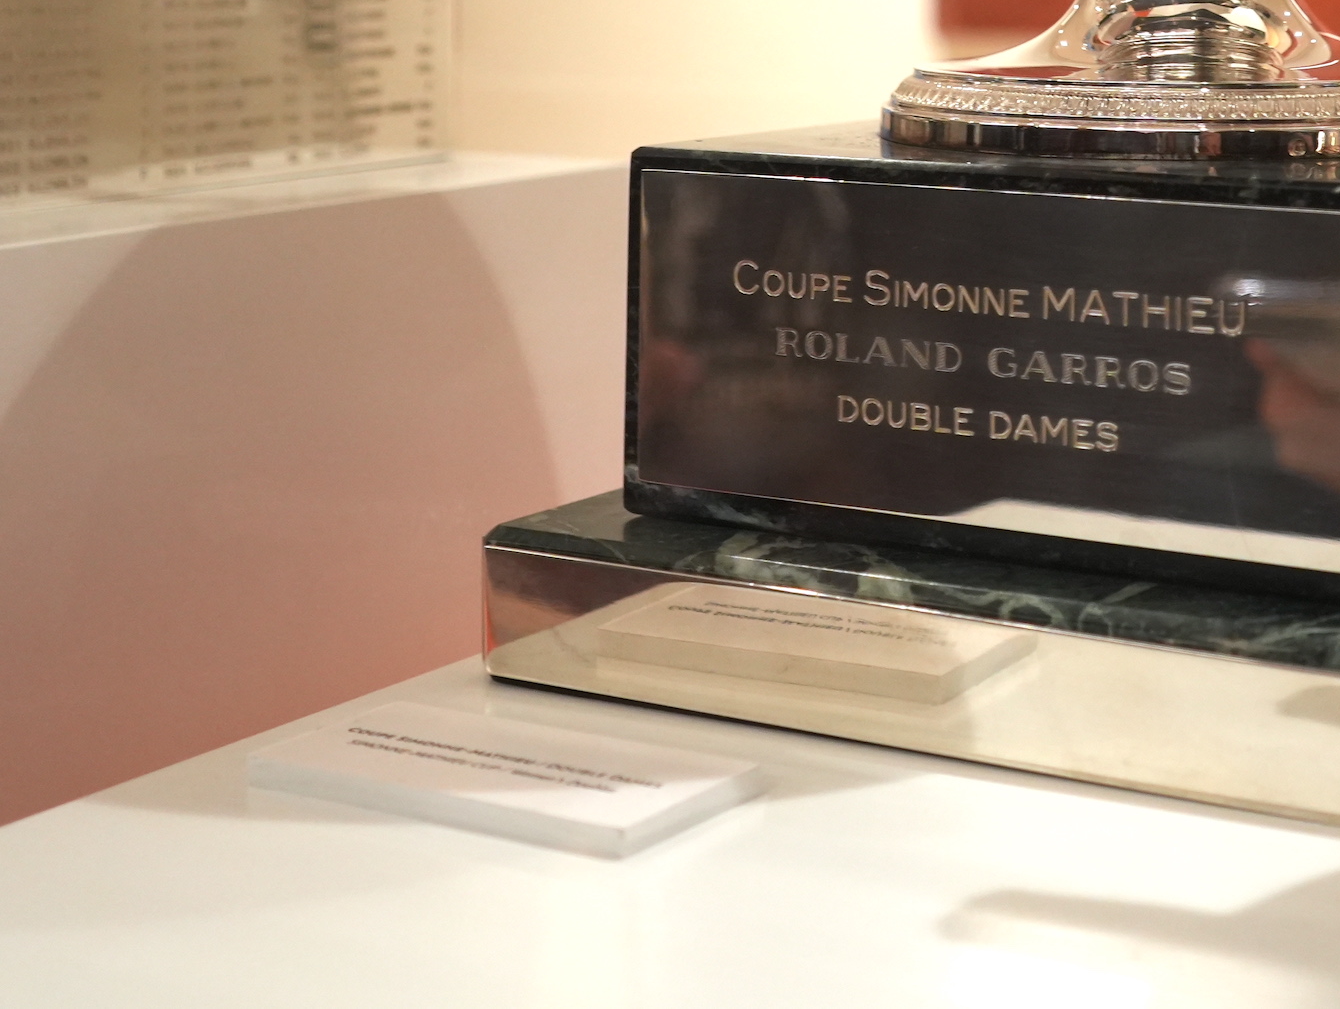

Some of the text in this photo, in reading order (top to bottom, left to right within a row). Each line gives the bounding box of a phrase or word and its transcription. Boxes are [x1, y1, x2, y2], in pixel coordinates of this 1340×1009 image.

[1042, 285, 1246, 337] MATHIEU
[774, 326, 1193, 396] ROLAND GARROS
[837, 394, 1120, 453] DOUBLE DAMES
